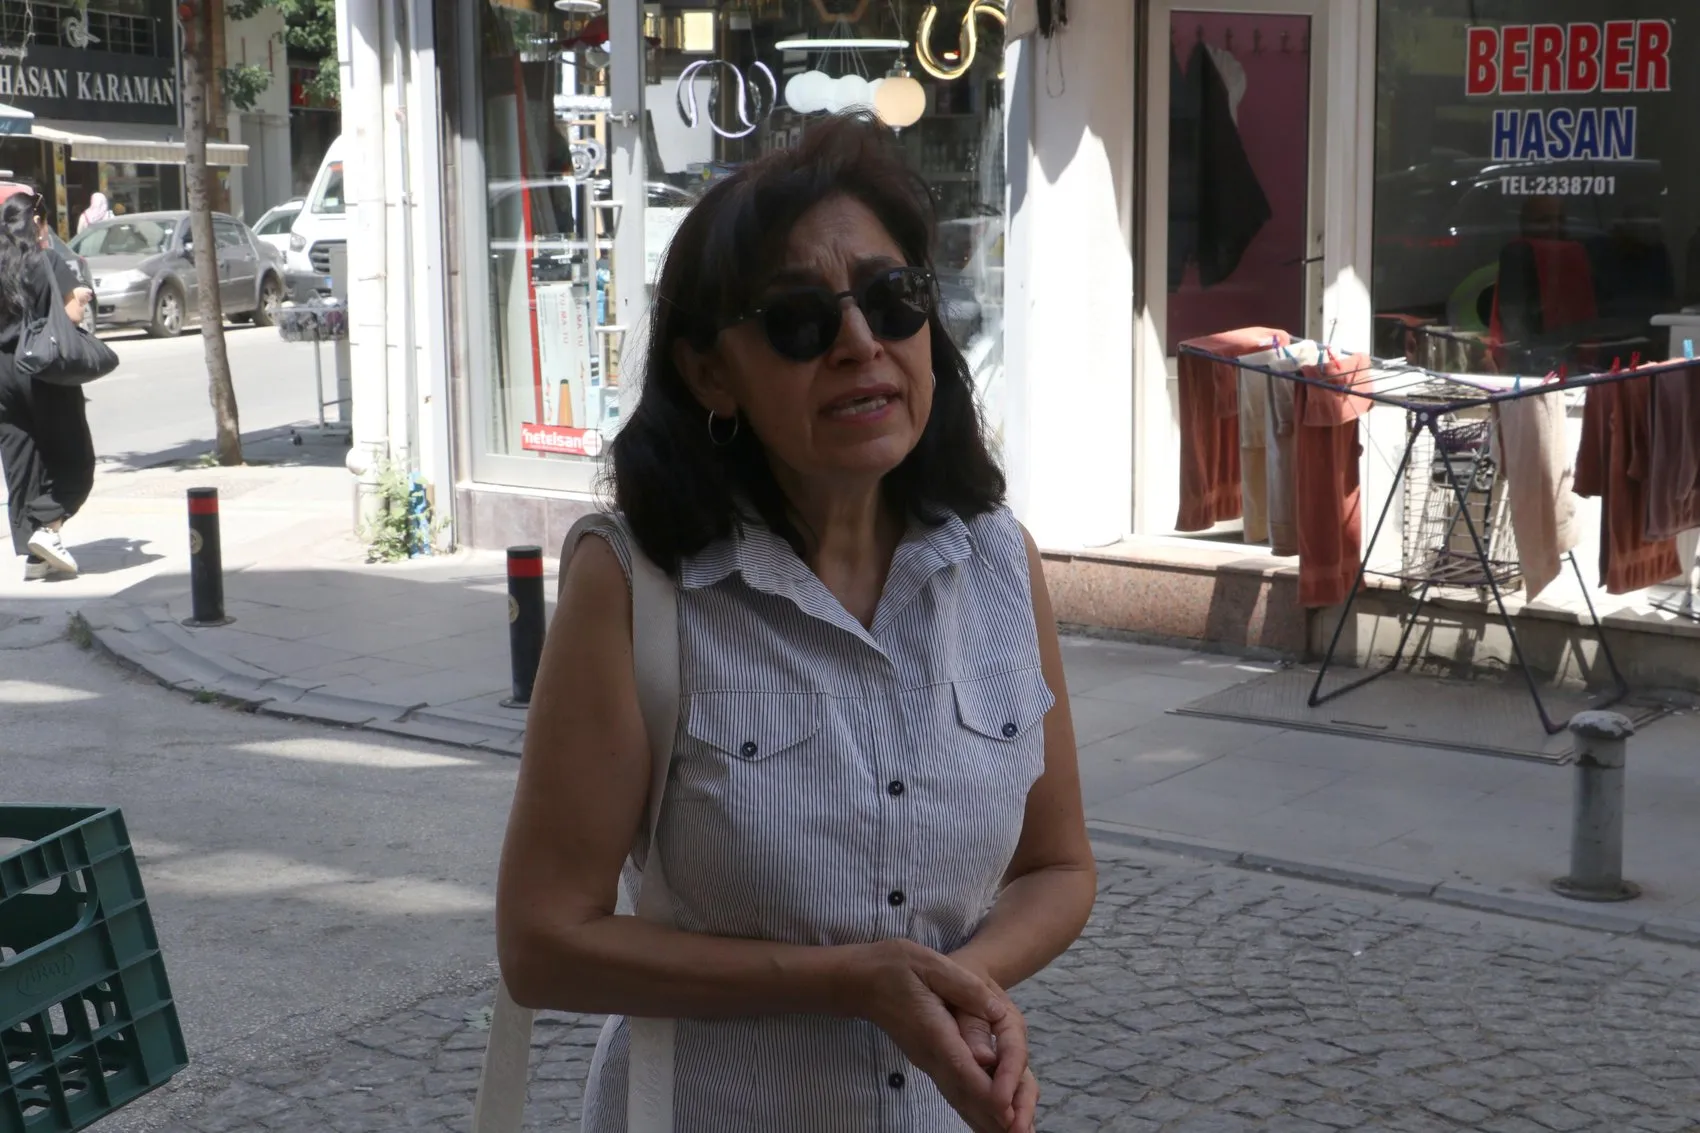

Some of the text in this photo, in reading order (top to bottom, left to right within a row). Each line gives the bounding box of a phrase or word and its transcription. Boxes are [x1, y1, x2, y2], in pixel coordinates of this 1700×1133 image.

[1465, 19, 1672, 96] BERBER
[0, 64, 175, 106] HASAN KARAMAN
[1491, 106, 1637, 161] HASAN
[1500, 176, 1616, 195] TEL:2338701
